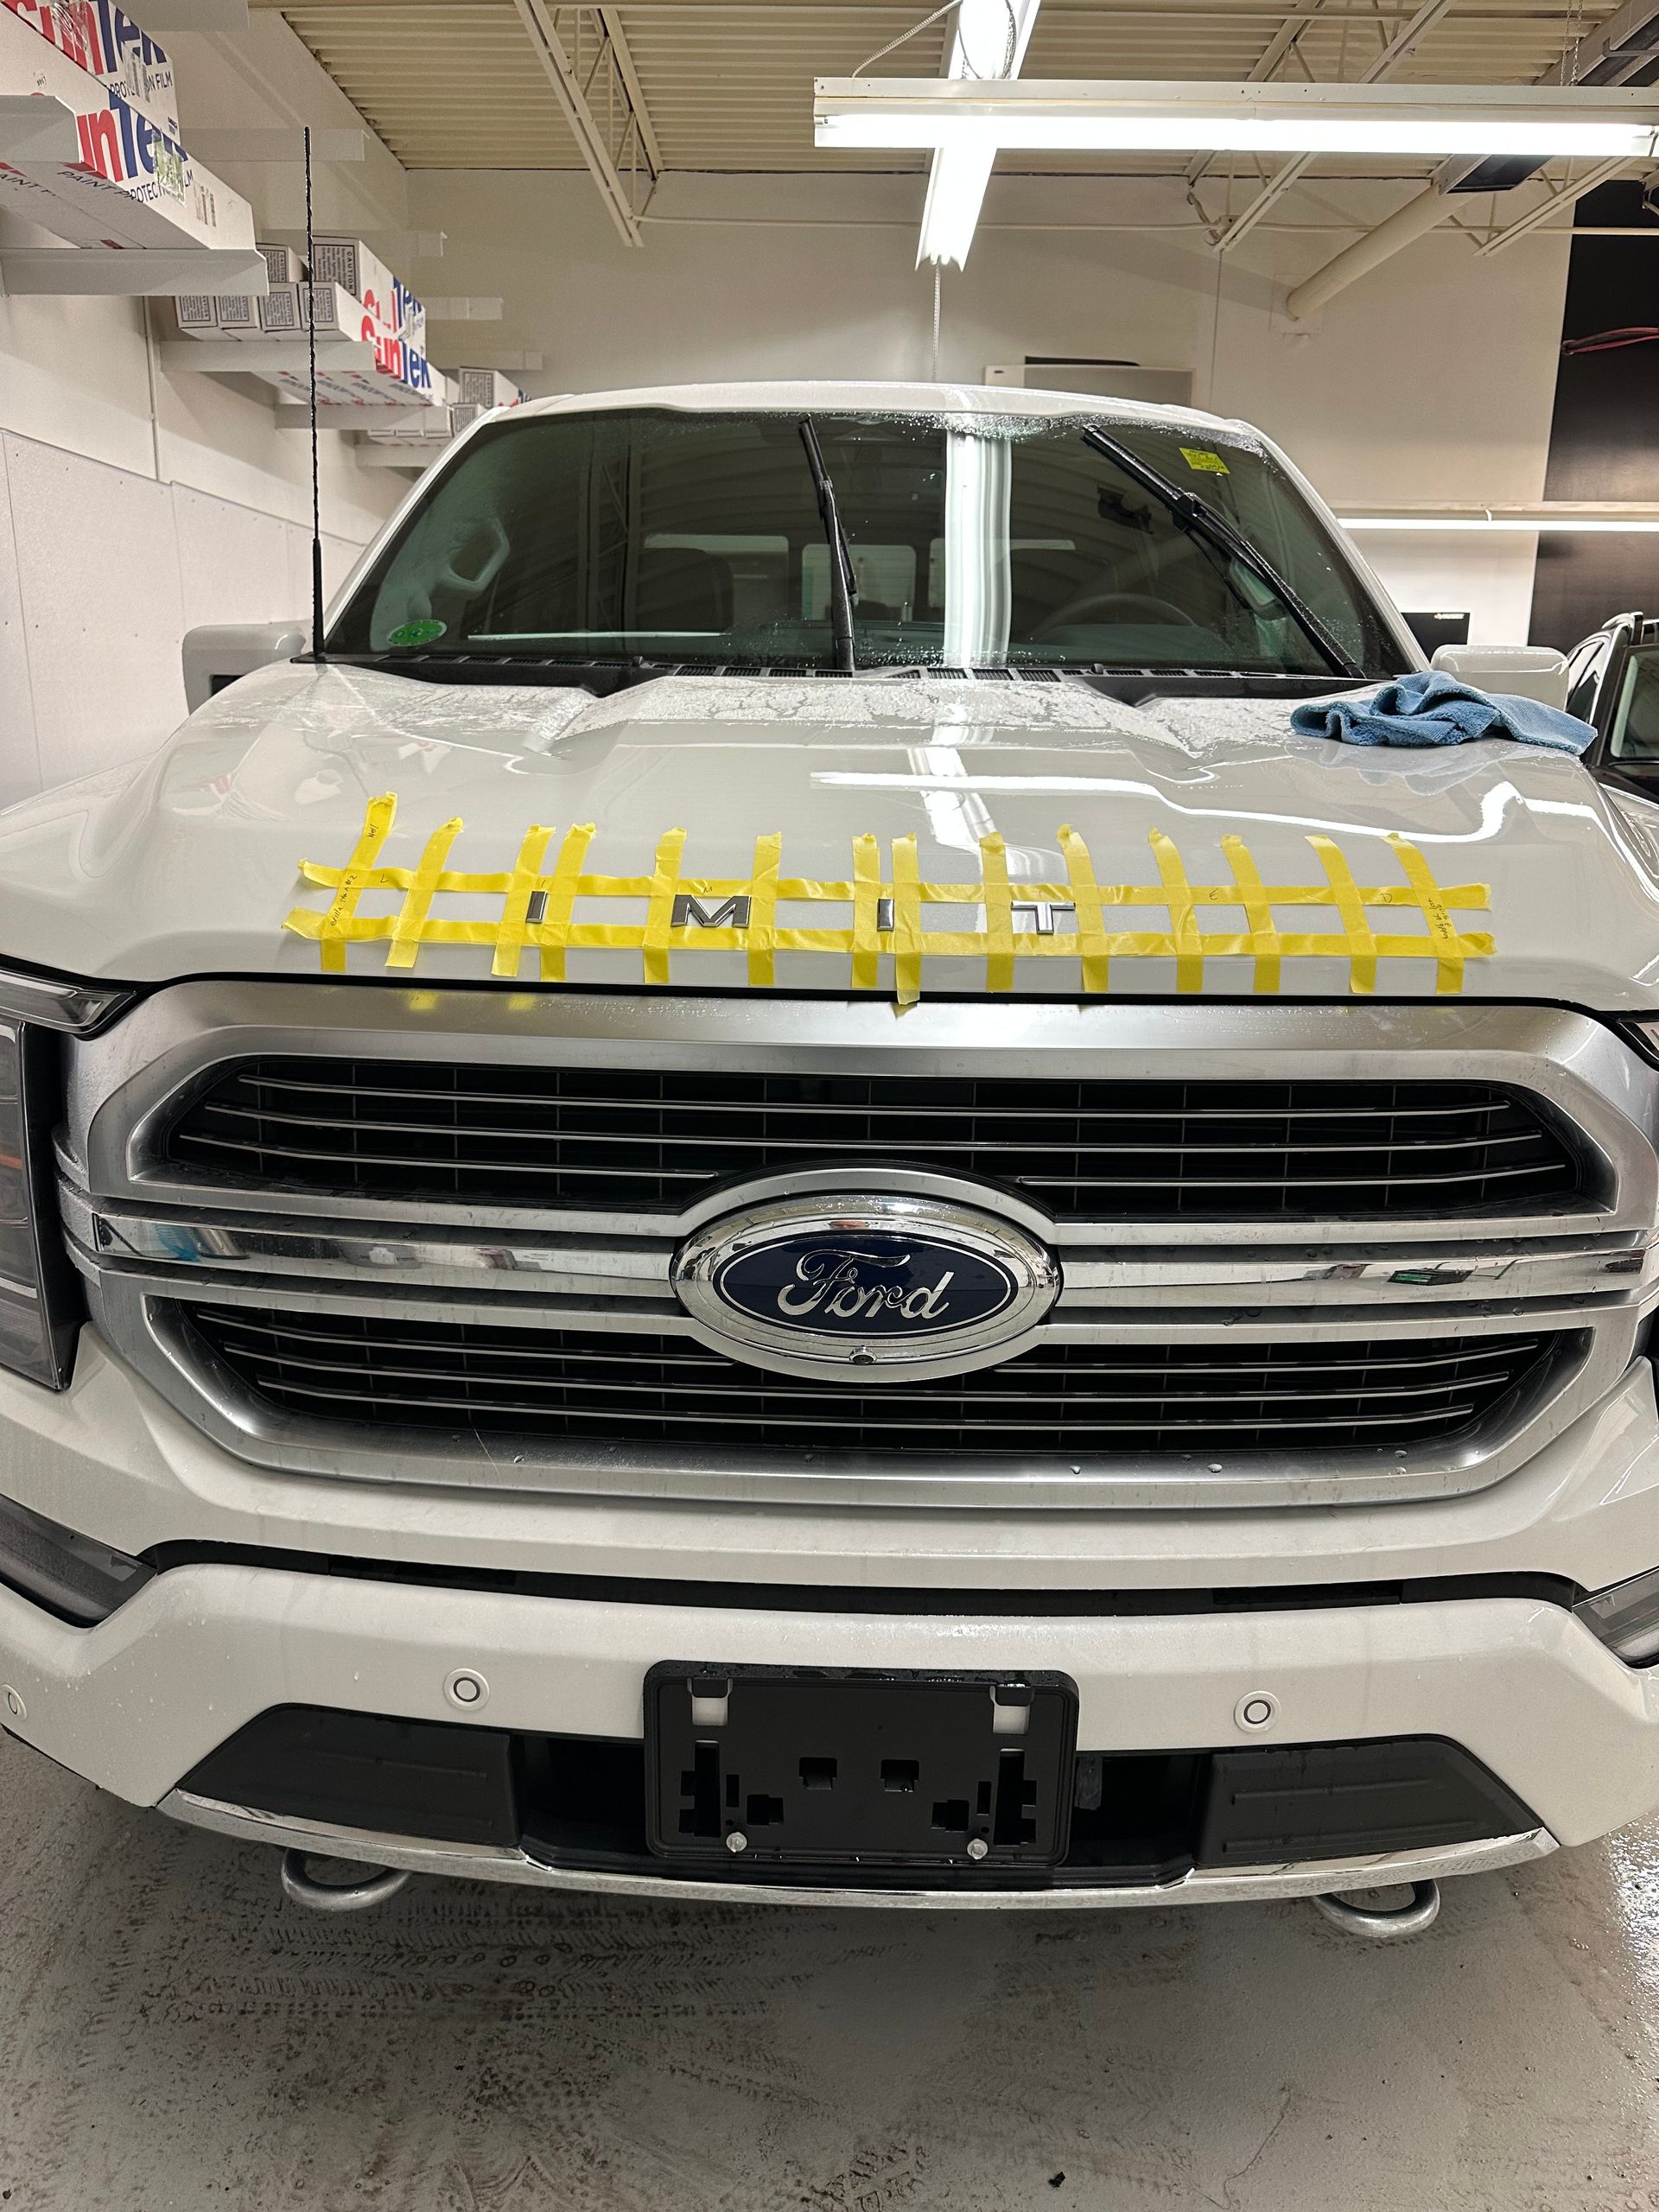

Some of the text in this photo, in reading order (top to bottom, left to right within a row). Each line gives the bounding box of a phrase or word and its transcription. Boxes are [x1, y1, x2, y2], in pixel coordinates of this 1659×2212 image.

[156, 71, 174, 90] FILM
[57, 170, 118, 191] PAINT
[346, 251, 355, 291] CAUTION
[670, 893, 753, 929] M
[1009, 899, 1077, 936] T
[776, 1249, 955, 1320] Ford
